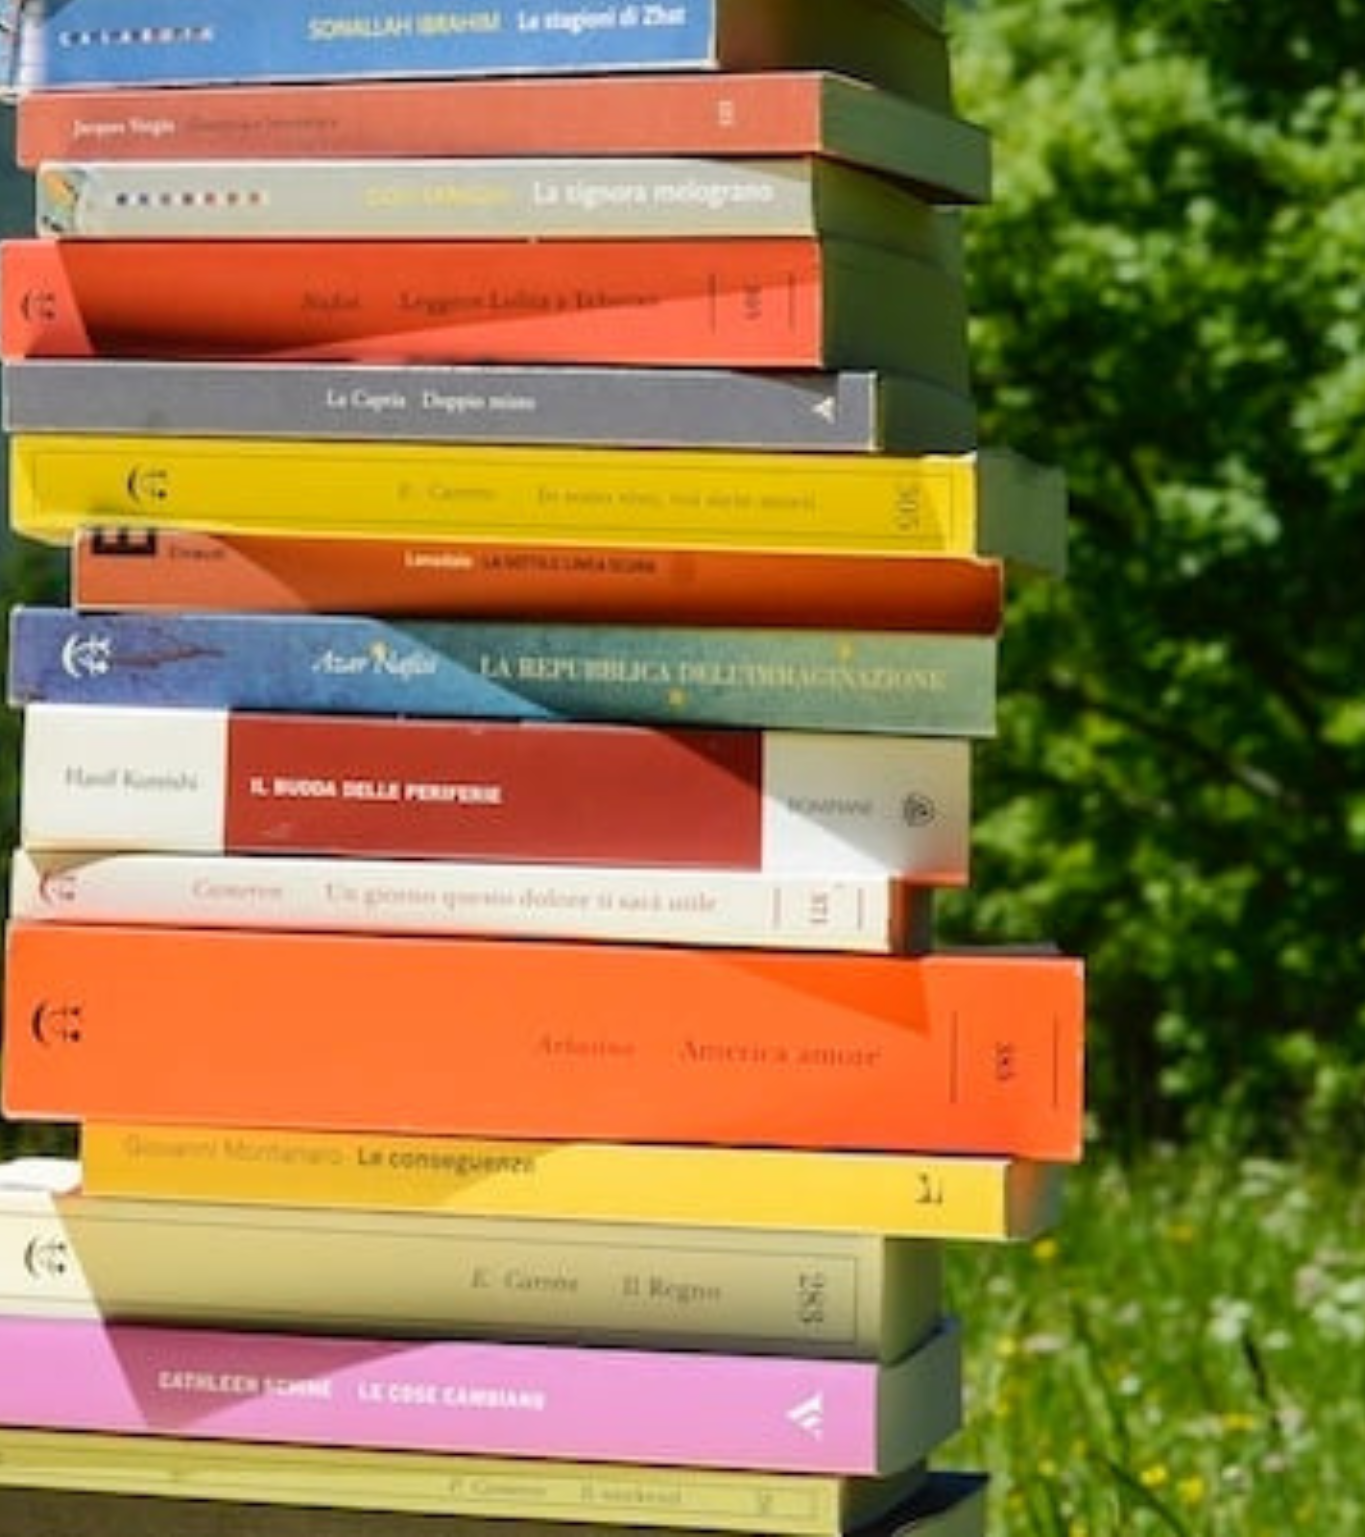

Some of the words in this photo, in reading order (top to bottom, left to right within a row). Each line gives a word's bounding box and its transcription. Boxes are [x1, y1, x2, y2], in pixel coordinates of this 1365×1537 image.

[307, 12, 411, 41] SONALLAH
[416, 10, 501, 35] IBRAHIM
[518, 10, 538, 31] Le
[544, 6, 613, 36] stagioni
[618, 3, 637, 26] di
[642, 1, 686, 26] Zhat
[533, 180, 560, 203] La
[564, 178, 647, 210] signora
[652, 179, 774, 210] melograno
[399, 291, 484, 317] Leggere
[489, 289, 551, 309] Lolita
[325, 388, 347, 408] La
[351, 389, 407, 412] Capria
[421, 391, 484, 415] Doppio
[312, 649, 368, 674] Azar
[372, 646, 438, 683] Nafisi
[480, 654, 512, 679] LA
[518, 657, 671, 682] REPUBBLICA
[679, 660, 947, 691] DELL'IMMAGINAZIONE
[65, 765, 118, 786] Hanif
[250, 776, 271, 796] IL
[273, 777, 337, 799] BUDDA
[342, 779, 402, 801] DELLE
[404, 781, 504, 806] PERIFERIE
[324, 880, 359, 902] Un
[362, 885, 437, 909] giorno
[442, 888, 514, 914] questo
[518, 888, 590, 910] dolore
[596, 892, 612, 910] ti
[668, 891, 717, 914] utile
[678, 1039, 788, 1063] America
[798, 1047, 881, 1066] amore
[223, 1137, 344, 1166] Montanaro
[356, 1145, 383, 1166] Le
[622, 1275, 640, 1296] Il
[649, 1275, 721, 1305] Regno
[157, 1369, 260, 1394] CATHLEEN
[357, 1382, 385, 1402] LE
[388, 1383, 440, 1405] COSE
[441, 1385, 546, 1411] CAMBIANO
